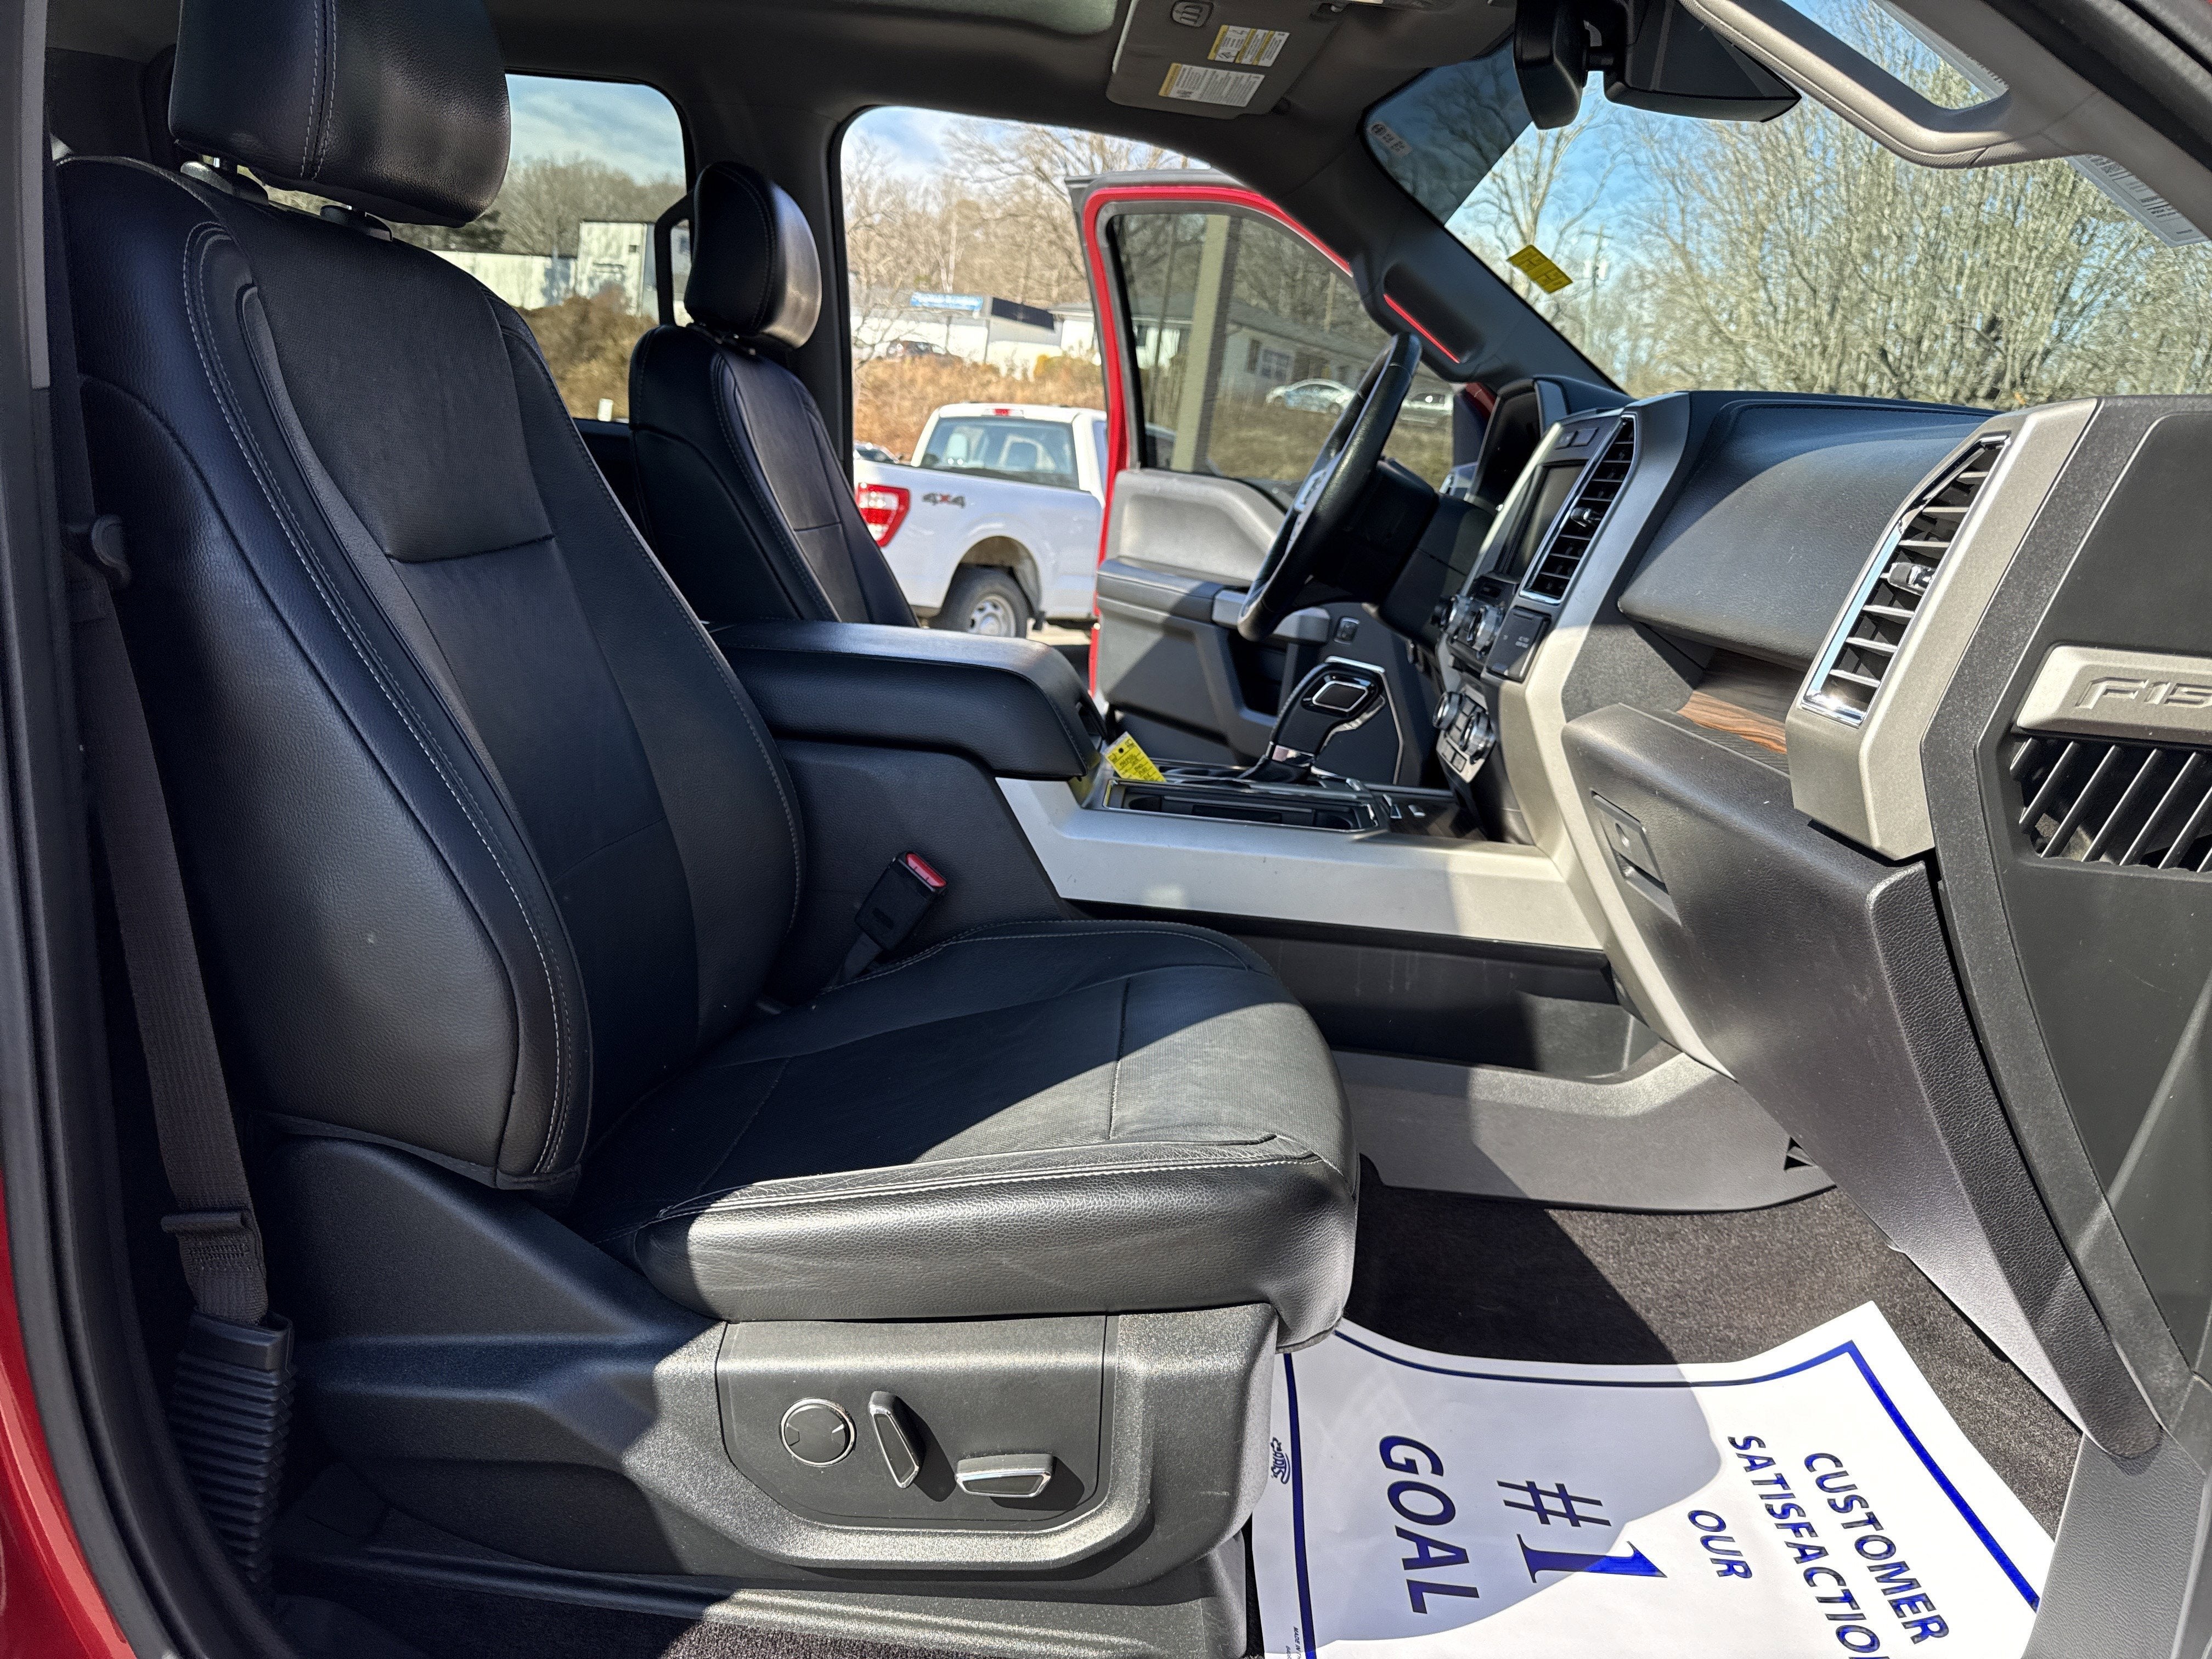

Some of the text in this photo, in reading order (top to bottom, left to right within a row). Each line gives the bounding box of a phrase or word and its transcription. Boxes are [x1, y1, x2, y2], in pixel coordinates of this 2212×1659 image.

[1379, 1435, 1480, 1614] GOAL
[1497, 1480, 1668, 1583] #1
[1688, 1510, 1752, 1578] OUR
[1728, 1436, 1891, 1659] SATISFACTIO
[1804, 1453, 1949, 1644] CUSTOMER
